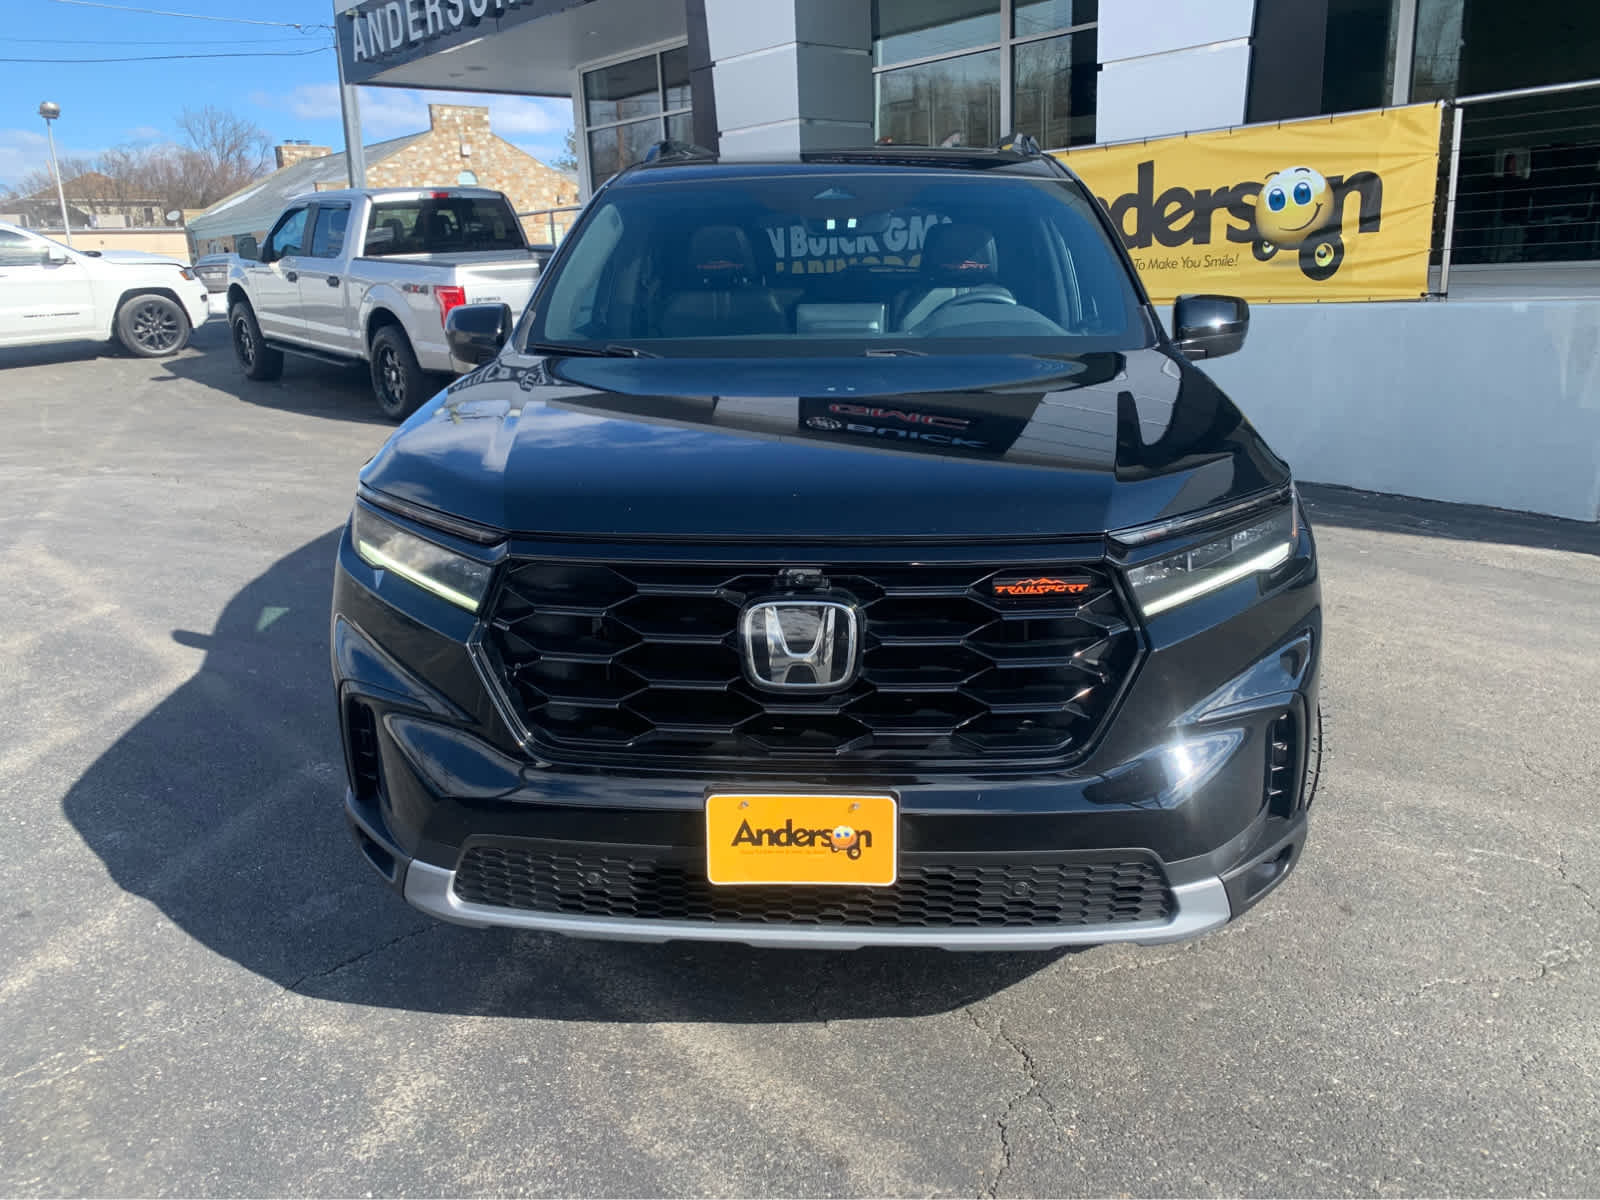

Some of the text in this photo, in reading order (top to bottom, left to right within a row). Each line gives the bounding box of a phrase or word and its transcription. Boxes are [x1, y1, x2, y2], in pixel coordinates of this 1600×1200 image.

[352, 0, 516, 62] ANDERS
[882, 216, 953, 251] GM
[1148, 257, 1178, 270] Make
[1181, 256, 1201, 269] You
[1203, 253, 1240, 268] Smile!
[994, 581, 1089, 595] TRAILSPORT
